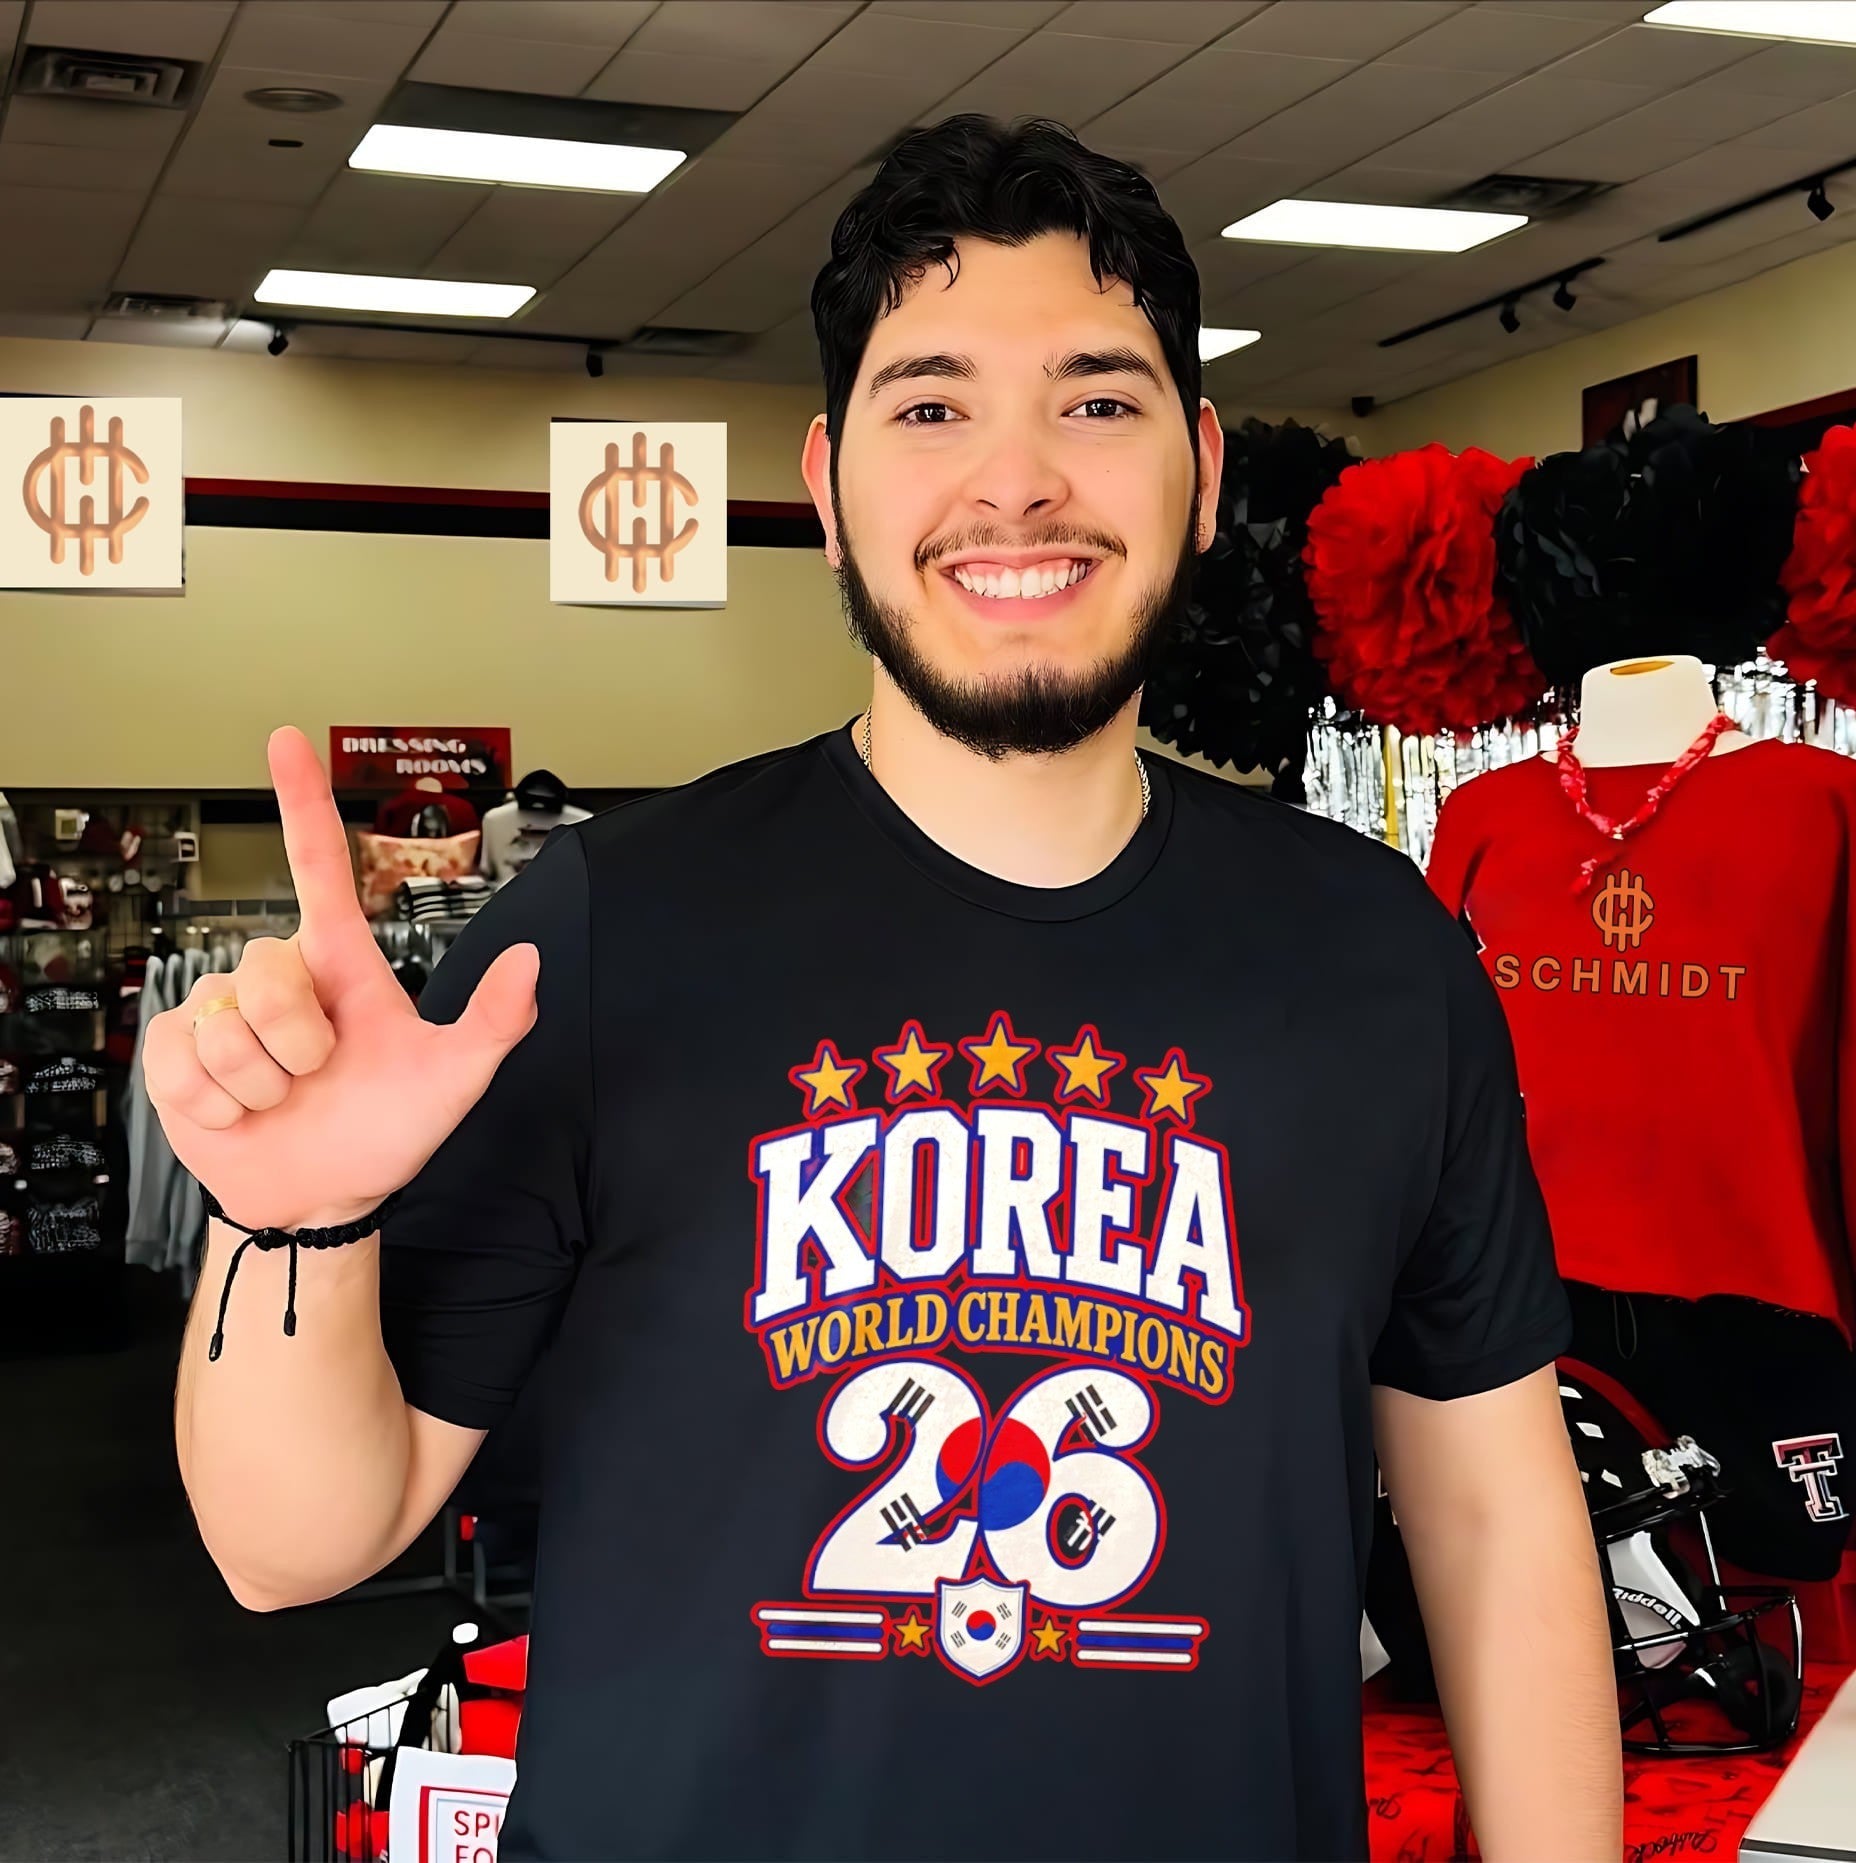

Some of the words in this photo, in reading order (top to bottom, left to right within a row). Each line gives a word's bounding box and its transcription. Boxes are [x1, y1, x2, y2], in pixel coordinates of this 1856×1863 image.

[396, 758, 487, 775] ROOMS
[1494, 954, 1747, 1001] SCHMIDT
[752, 1106, 1245, 1339] KOREA
[768, 1291, 949, 1379] WORLD
[956, 1289, 1227, 1397] CHAMPIONS
[807, 1359, 1160, 1609] 26
